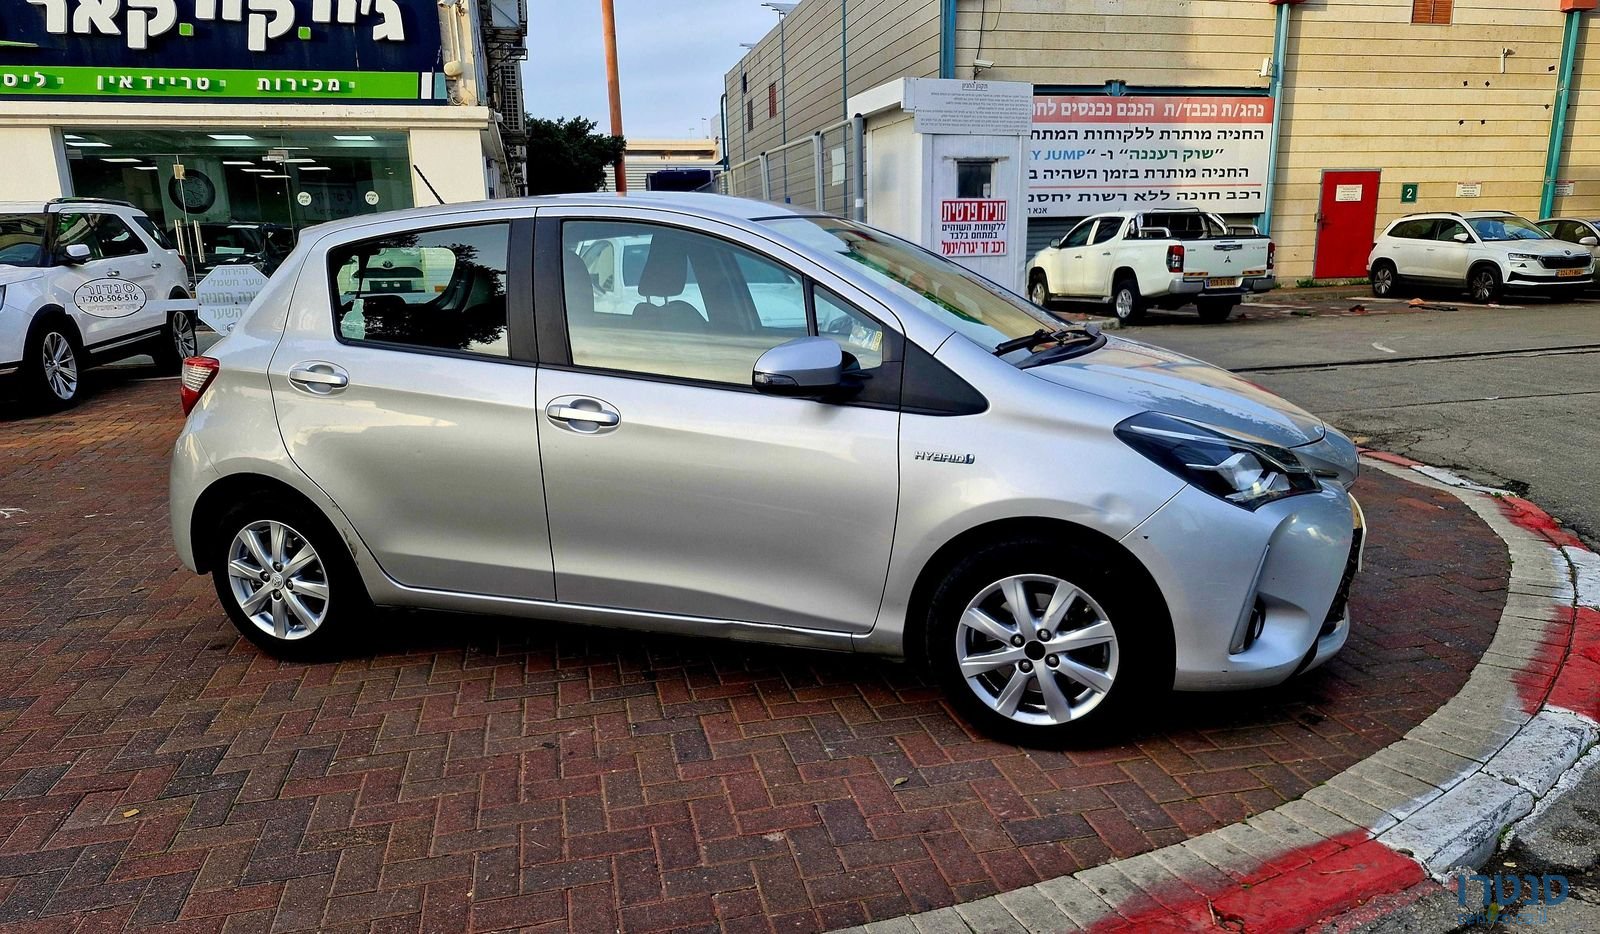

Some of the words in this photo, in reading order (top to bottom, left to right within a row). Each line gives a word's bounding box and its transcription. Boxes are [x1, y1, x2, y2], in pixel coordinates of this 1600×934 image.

[256, 77, 340, 91] מכירות
[1061, 102, 1113, 117] נכנסים
[1116, 103, 1155, 117] הנכם
[1164, 103, 1218, 117] נכבד/ת
[1221, 103, 1264, 117] נהג/ת
[1083, 126, 1155, 143] ללקוחות
[1159, 129, 1212, 140] מותרת
[1217, 130, 1264, 140] החניה
[1043, 169, 1097, 180] השהיה
[1102, 169, 1140, 182] בזמן
[1144, 168, 1197, 179] מותרת
[1201, 168, 1249, 178] החניה
[1077, 193, 1127, 202] רשות
[1133, 190, 1170, 202] ללא
[1176, 191, 1220, 200] חונה
[1225, 191, 1261, 200] רכב
[1406, 188, 1413, 199] 2
[942, 202, 978, 222] פרטית
[981, 202, 1006, 222] חניה
[974, 223, 1006, 232] ללקוחות
[949, 232, 969, 240] בלבד
[980, 241, 989, 253] זר
[991, 241, 1005, 253] רכב
[208, 278, 240, 287] חשמלי
[83, 283, 136, 295] סנדור
[82, 293, 139, 303] 1-700-506-516
[914, 451, 966, 464] HYBRID
